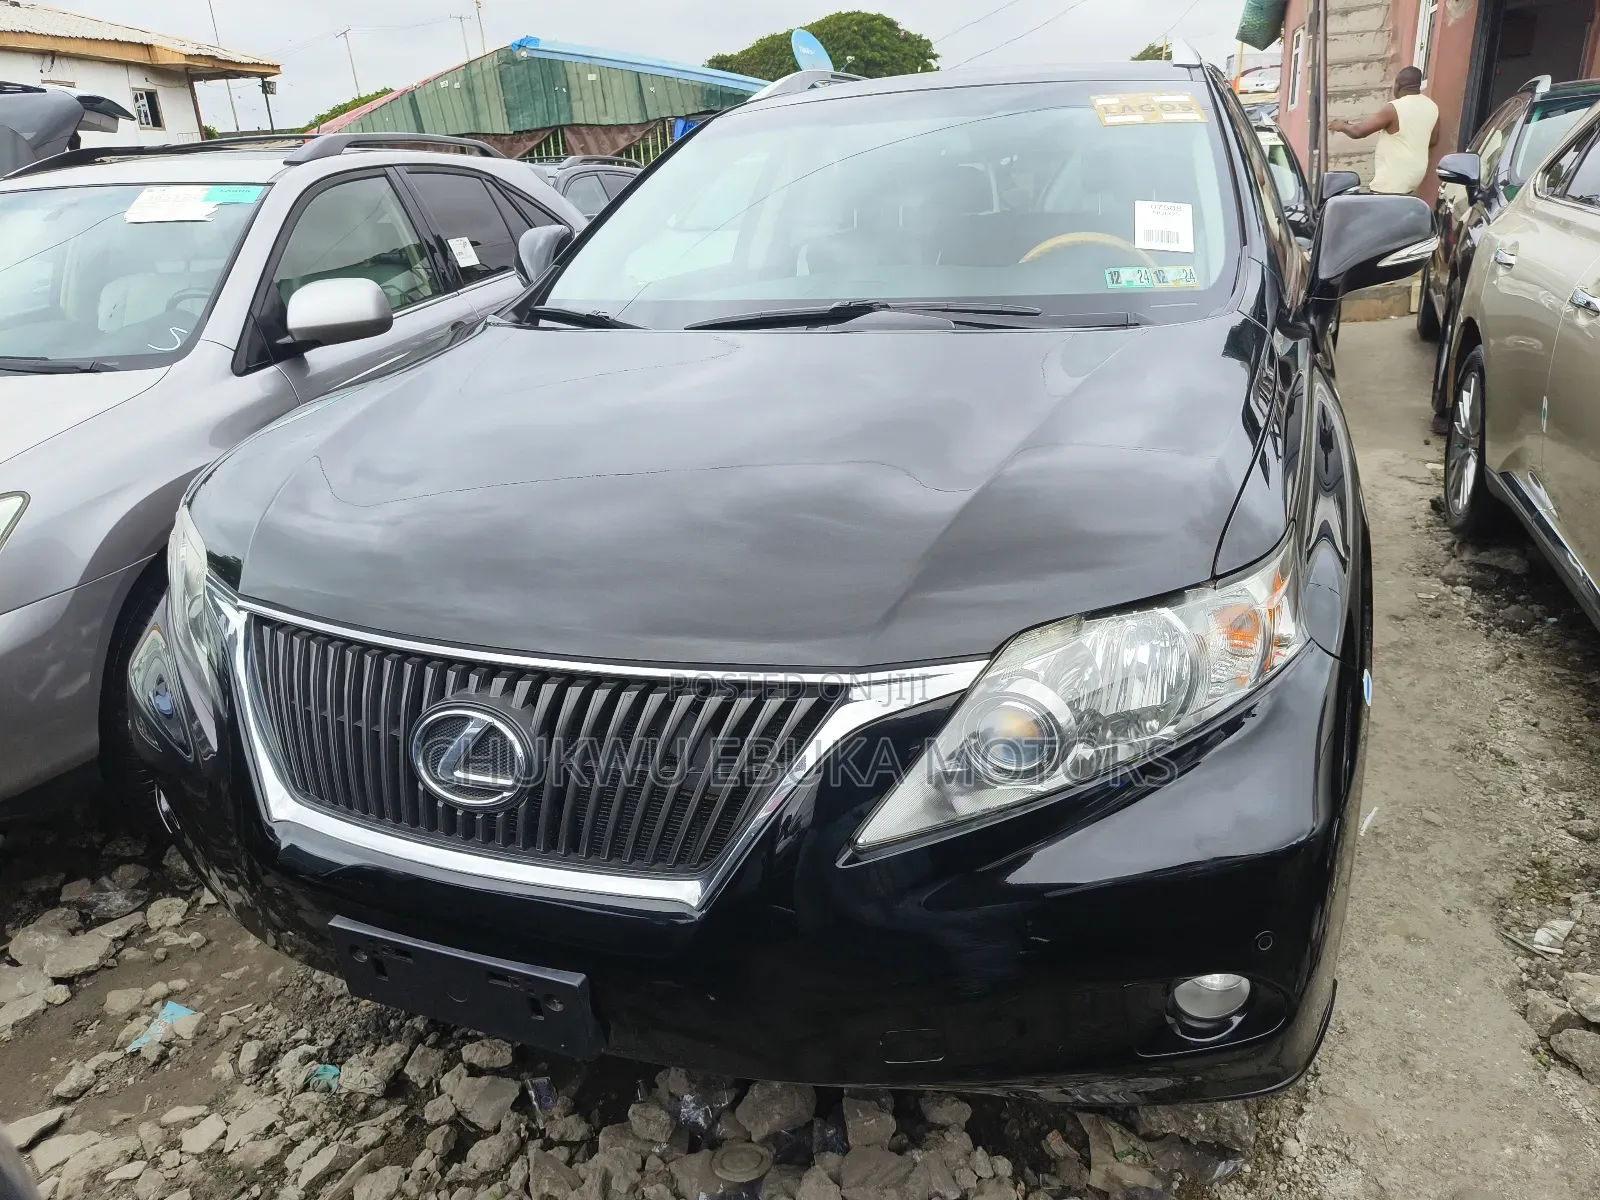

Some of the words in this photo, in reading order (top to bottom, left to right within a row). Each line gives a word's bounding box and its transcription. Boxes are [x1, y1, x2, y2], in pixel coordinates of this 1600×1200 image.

[1103, 103, 1195, 115] LAGOS
[1108, 270, 1122, 284] 12
[1137, 270, 1150, 284] 24
[1153, 270, 1169, 283] 12
[1182, 269, 1196, 283] 24
